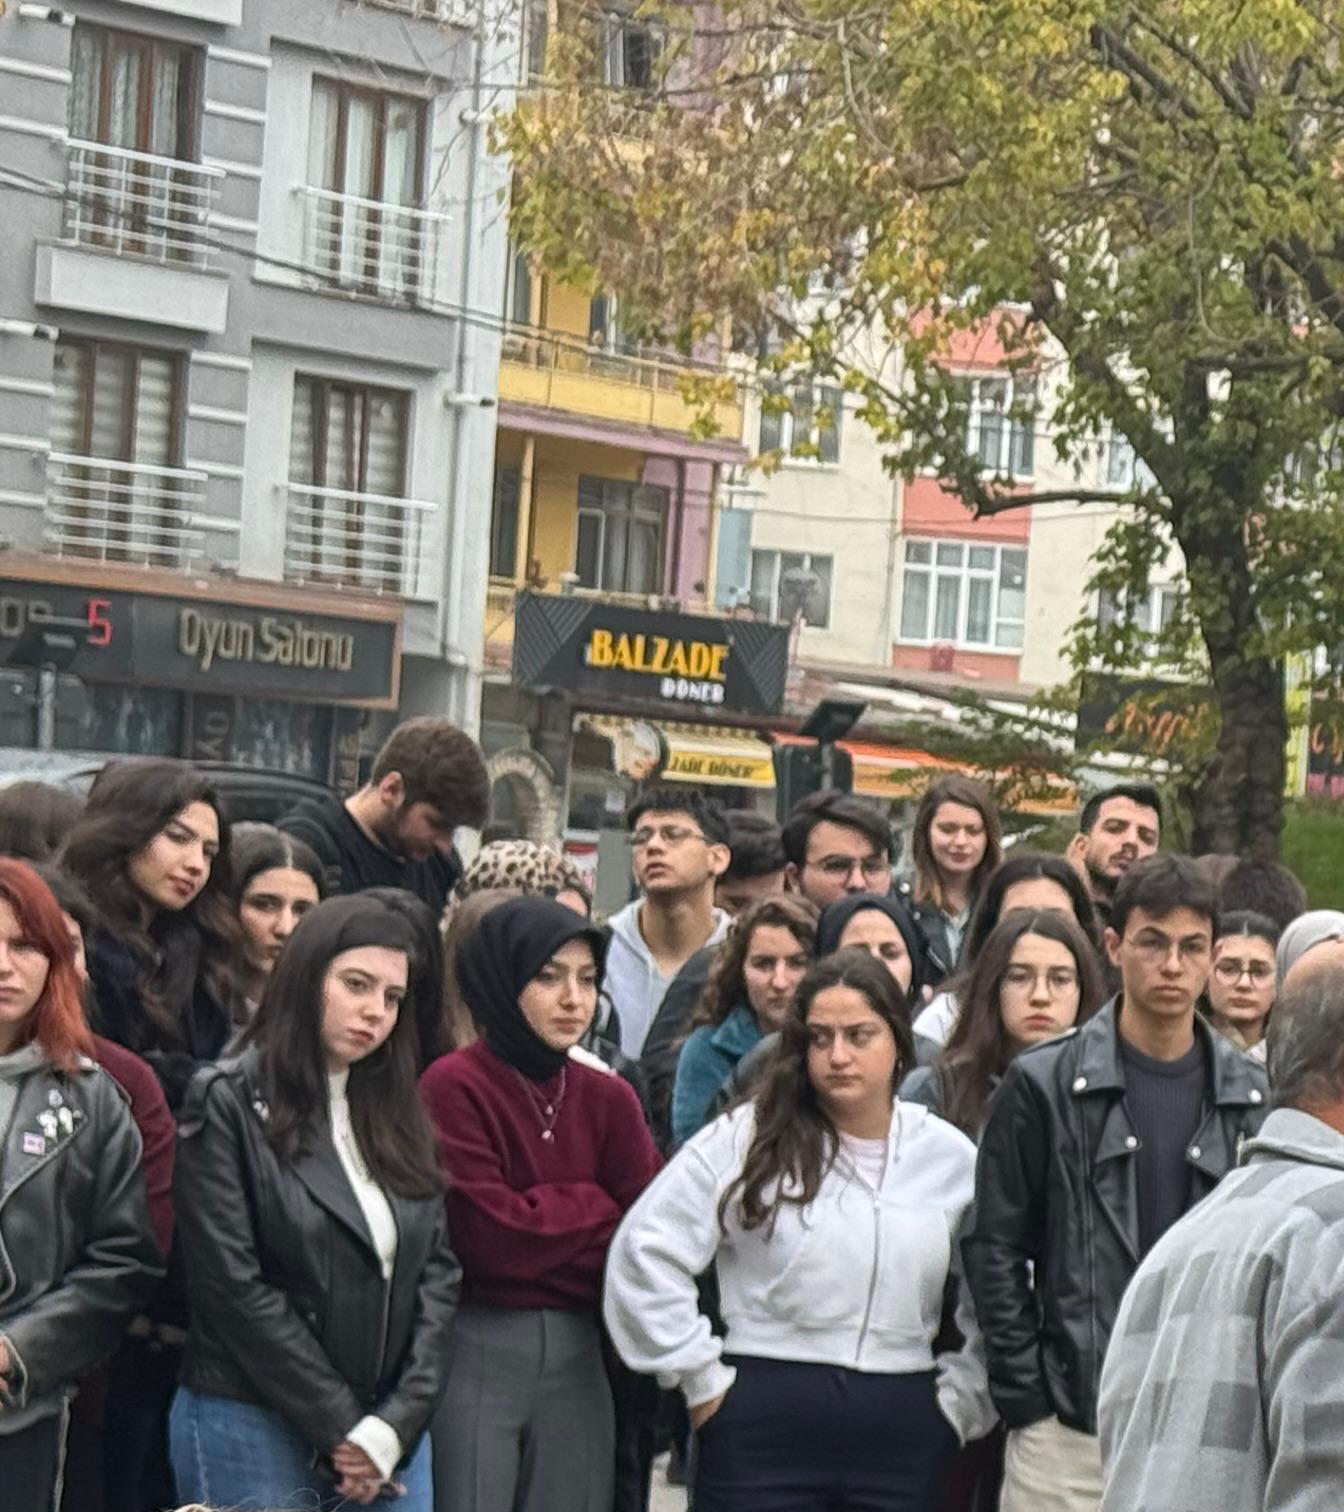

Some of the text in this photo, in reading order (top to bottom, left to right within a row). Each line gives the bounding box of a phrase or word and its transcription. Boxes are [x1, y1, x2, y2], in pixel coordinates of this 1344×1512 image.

[86, 598, 113, 647] 5
[179, 608, 354, 672] Oyun Salonu
[588, 628, 730, 681] BALZADE
